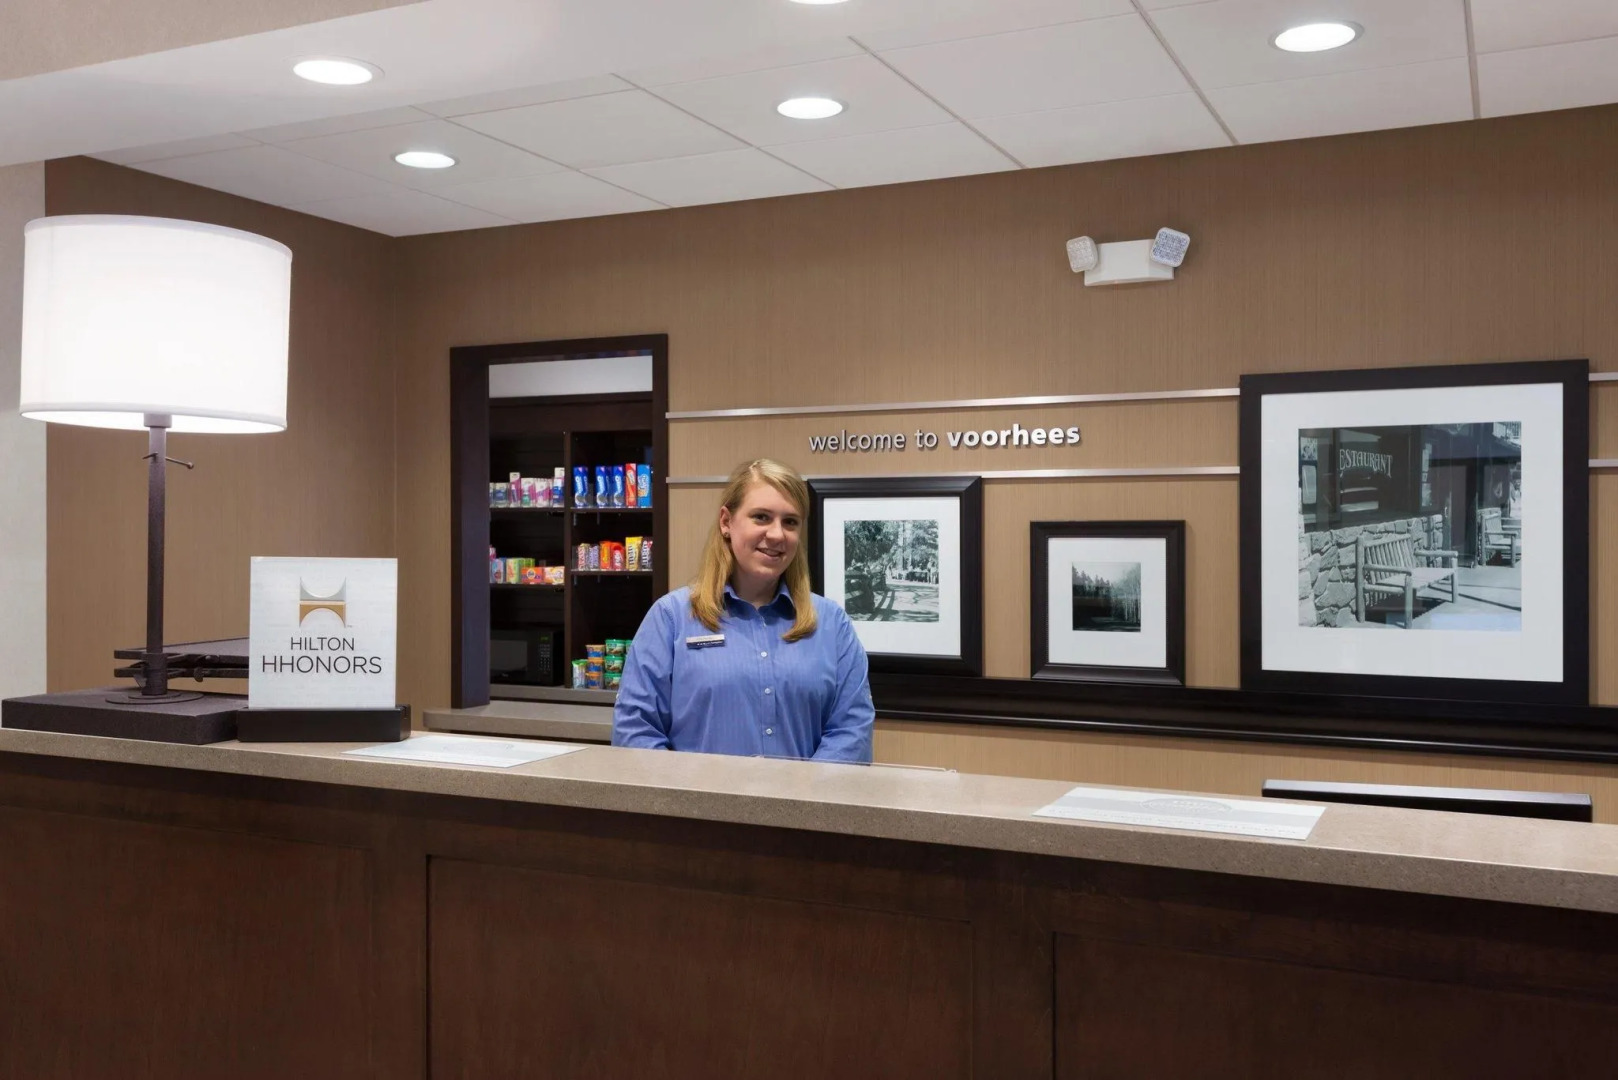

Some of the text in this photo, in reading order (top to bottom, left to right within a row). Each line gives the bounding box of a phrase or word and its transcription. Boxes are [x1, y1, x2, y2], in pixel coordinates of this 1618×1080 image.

[809, 423, 1081, 452] welcome to voorhees
[1339, 448, 1393, 478] ESTAURANT
[290, 636, 356, 651] HILTON
[262, 655, 383, 674] HHONORS
